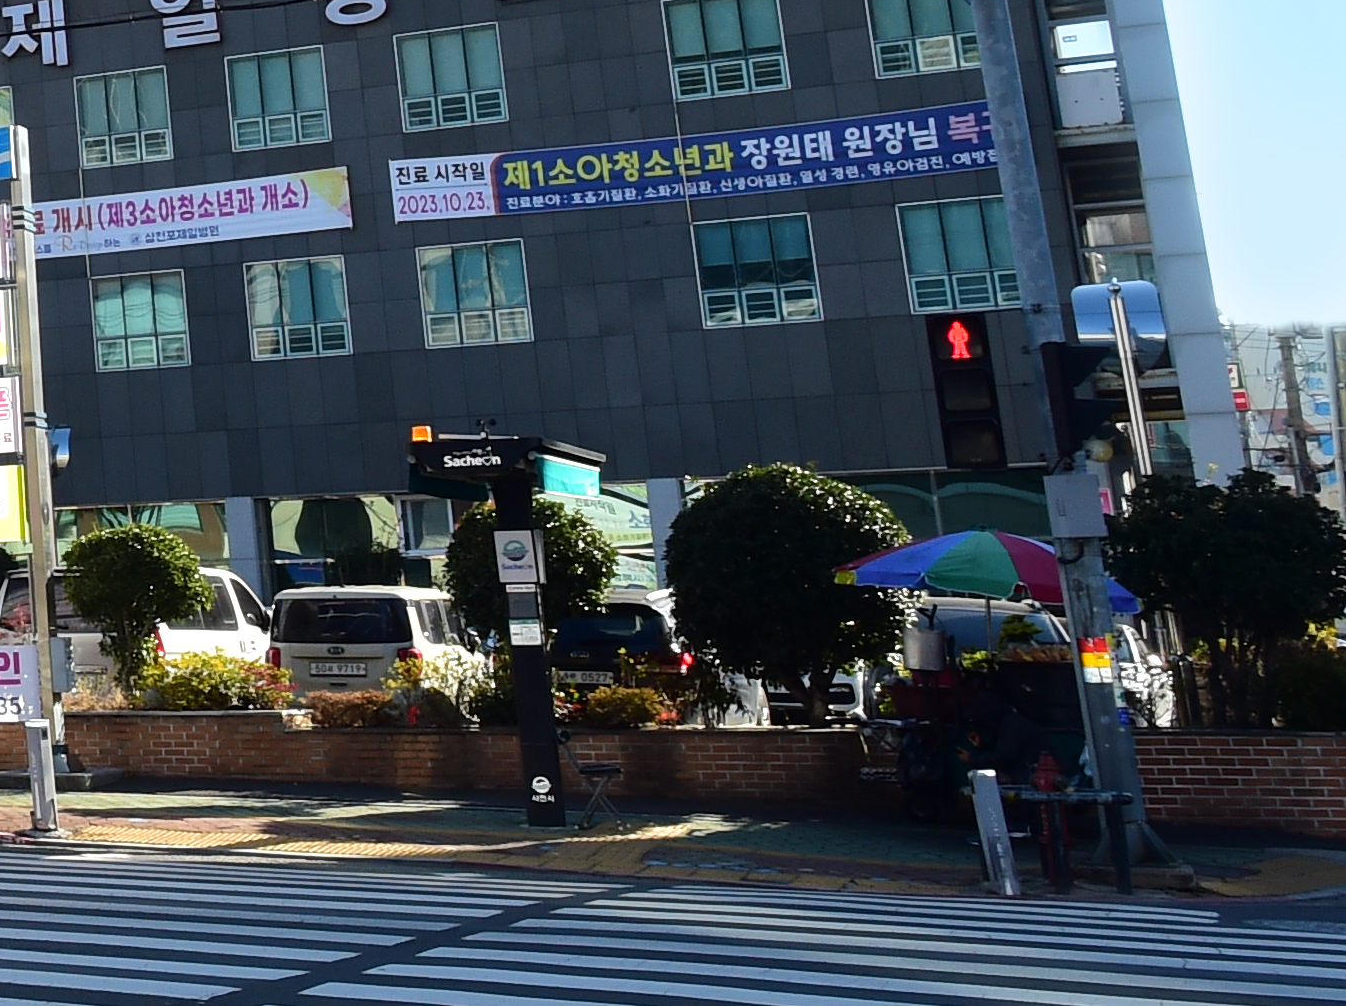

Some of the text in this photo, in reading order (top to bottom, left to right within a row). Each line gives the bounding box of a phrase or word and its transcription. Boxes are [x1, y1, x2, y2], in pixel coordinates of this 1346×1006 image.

[503, 142, 734, 189] 제1소아청소년과
[741, 130, 834, 169] 장원태
[843, 117, 939, 158] 원장님
[396, 161, 486, 184] 진료 시작일
[52, 204, 93, 233] 개시
[260, 179, 309, 211] 개소)
[398, 191, 490, 215] 2023.10.23.
[145, 225, 220, 244] 삼천포제일병원
